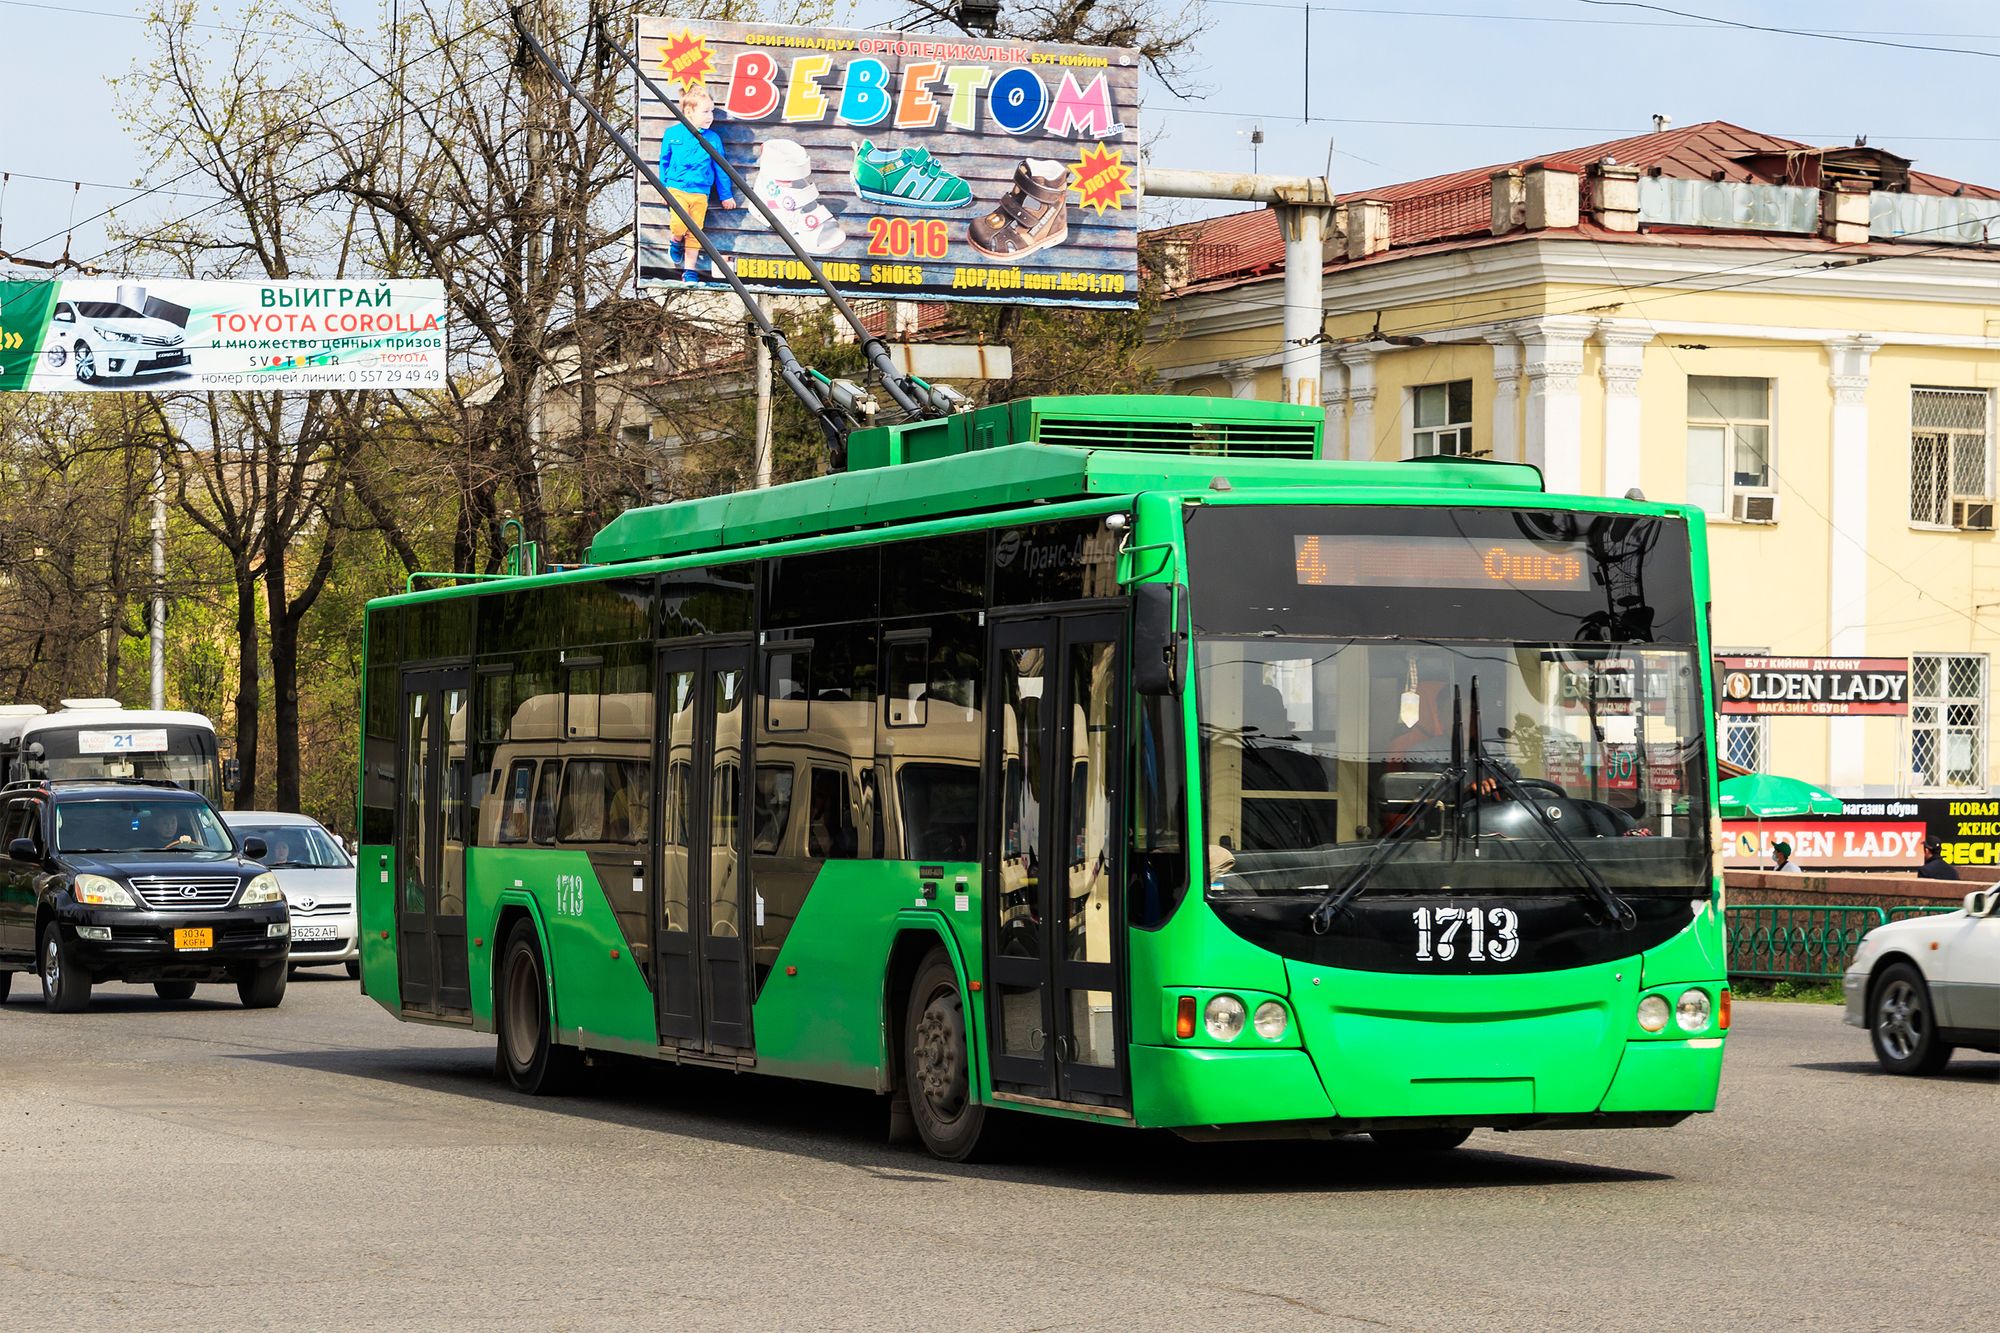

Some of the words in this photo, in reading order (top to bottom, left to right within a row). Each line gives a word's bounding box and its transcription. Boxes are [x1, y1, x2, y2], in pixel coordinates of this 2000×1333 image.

[745, 34, 856, 51] ОРИГИНАЛДУУ
[859, 39, 1029, 64] ОРТОПЕДИКАЛЫК
[1031, 53, 1057, 66] БУТ
[1059, 52, 1108, 68] КИЙИМ
[1084, 165, 1119, 195] лето
[868, 216, 949, 259] 2016
[953, 266, 1021, 289] ДОРДОЙ
[261, 283, 392, 307] ВЫИГРАЙ
[211, 314, 317, 333] TOYOTA
[324, 314, 440, 332] COROLLA
[211, 340, 220, 349] и
[226, 339, 317, 349] множество
[322, 338, 381, 351] ценных
[386, 338, 441, 351] призов
[381, 353, 428, 363] TOYOTA
[202, 374, 243, 386] номер
[246, 372, 298, 386] горячей
[301, 373, 346, 382] линии:
[349, 371, 357, 382] 0
[360, 371, 383, 382] 557
[387, 371, 402, 382] 29
[405, 371, 420, 382] 49
[424, 371, 440, 382] 49
[1296, 536, 1327, 584] 4
[1745, 659, 1766, 669] БУТ
[1769, 658, 1809, 669] КИЙИМ
[1722, 672, 1824, 700] OLDEN
[1829, 674, 1907, 701] LADY
[1757, 702, 1808, 713] МАГАЗИН
[1811, 703, 1849, 714] ОБУВИ
[113, 734, 133, 747] 21
[1842, 803, 1885, 816] магазин
[1887, 802, 1918, 818] обуви
[1949, 802, 1999, 816] НОВАЯ
[1843, 831, 1922, 858] LADY
[556, 874, 584, 917] 1713
[182, 929, 206, 938] 3034
[1412, 906, 1520, 962] 1713
